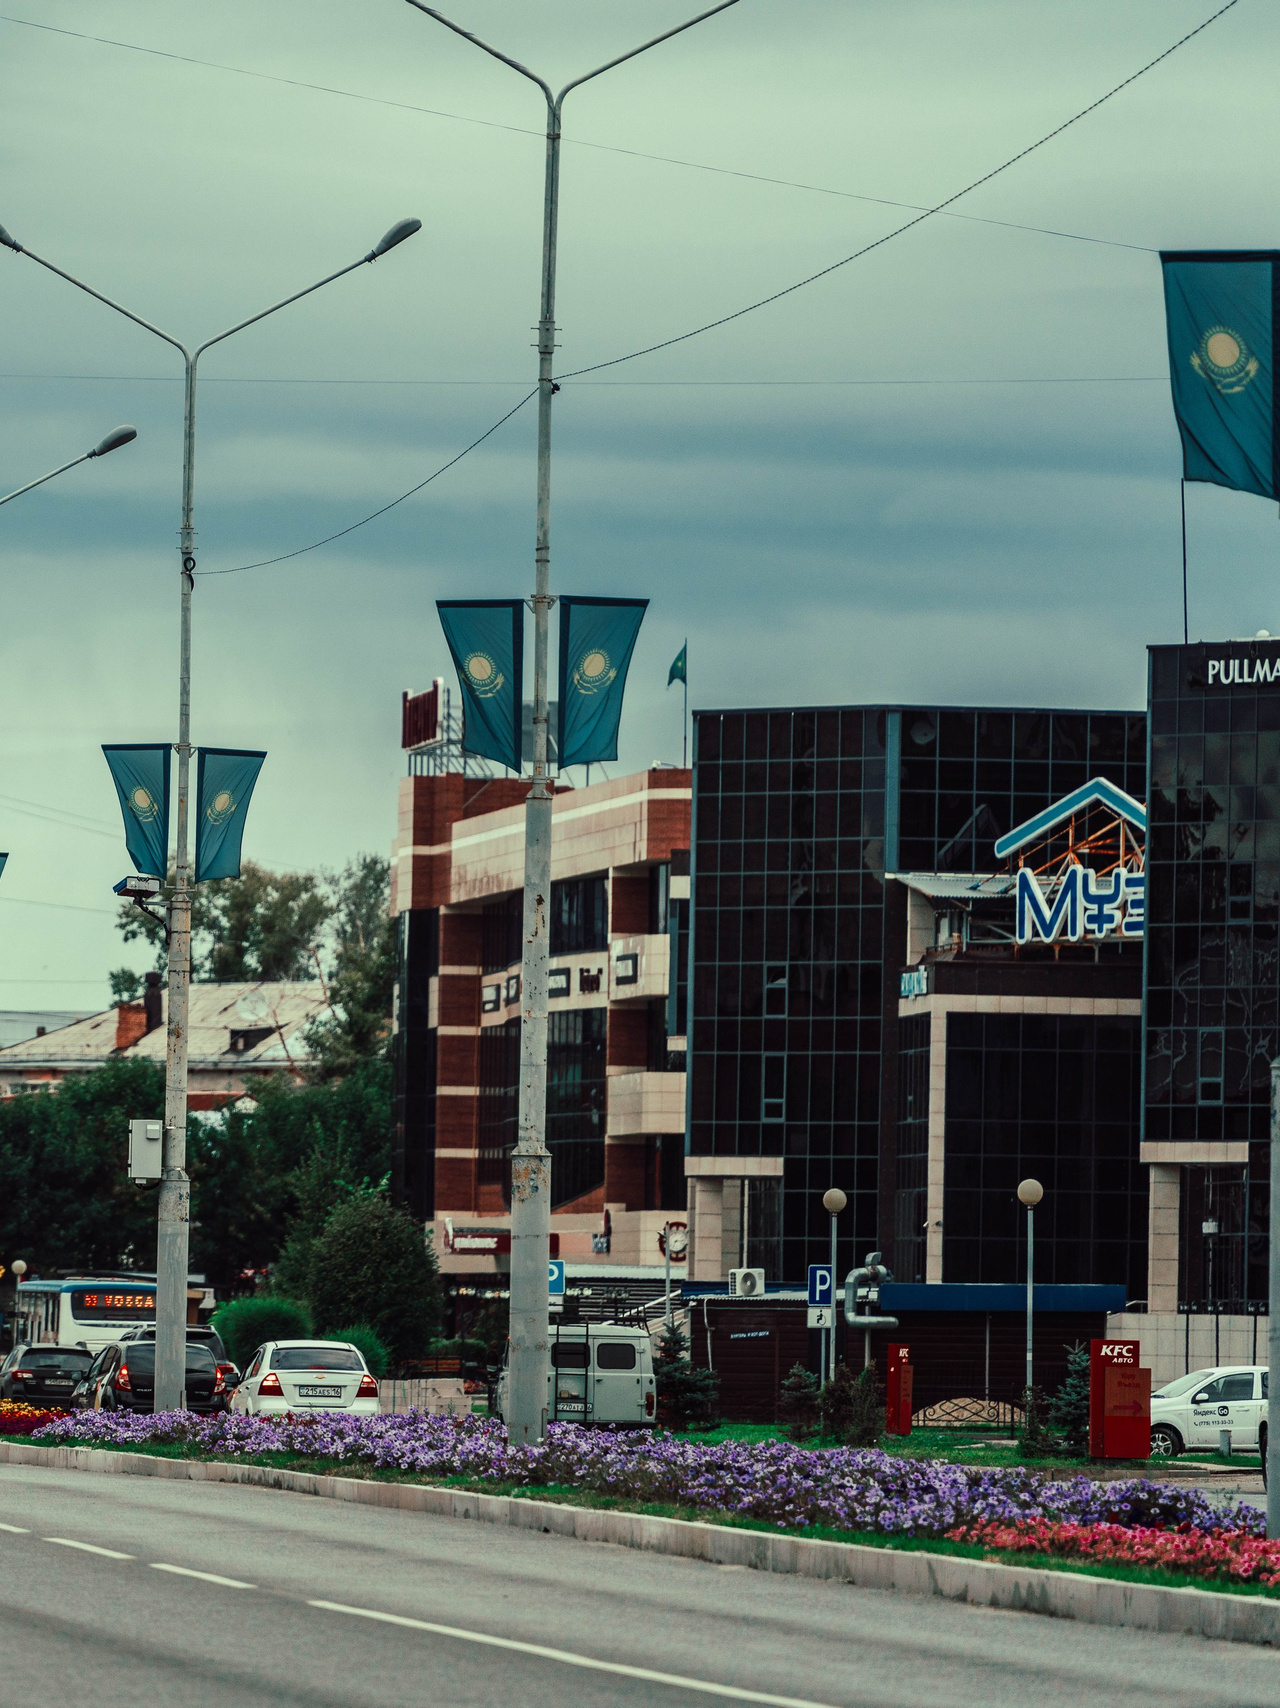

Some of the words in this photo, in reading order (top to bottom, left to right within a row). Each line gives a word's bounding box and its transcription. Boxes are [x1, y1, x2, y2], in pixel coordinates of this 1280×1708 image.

[1101, 1345, 1133, 1356] KFC
[1194, 1408, 1217, 1417] Яндекс
[1219, 1407, 1229, 1415] Go
